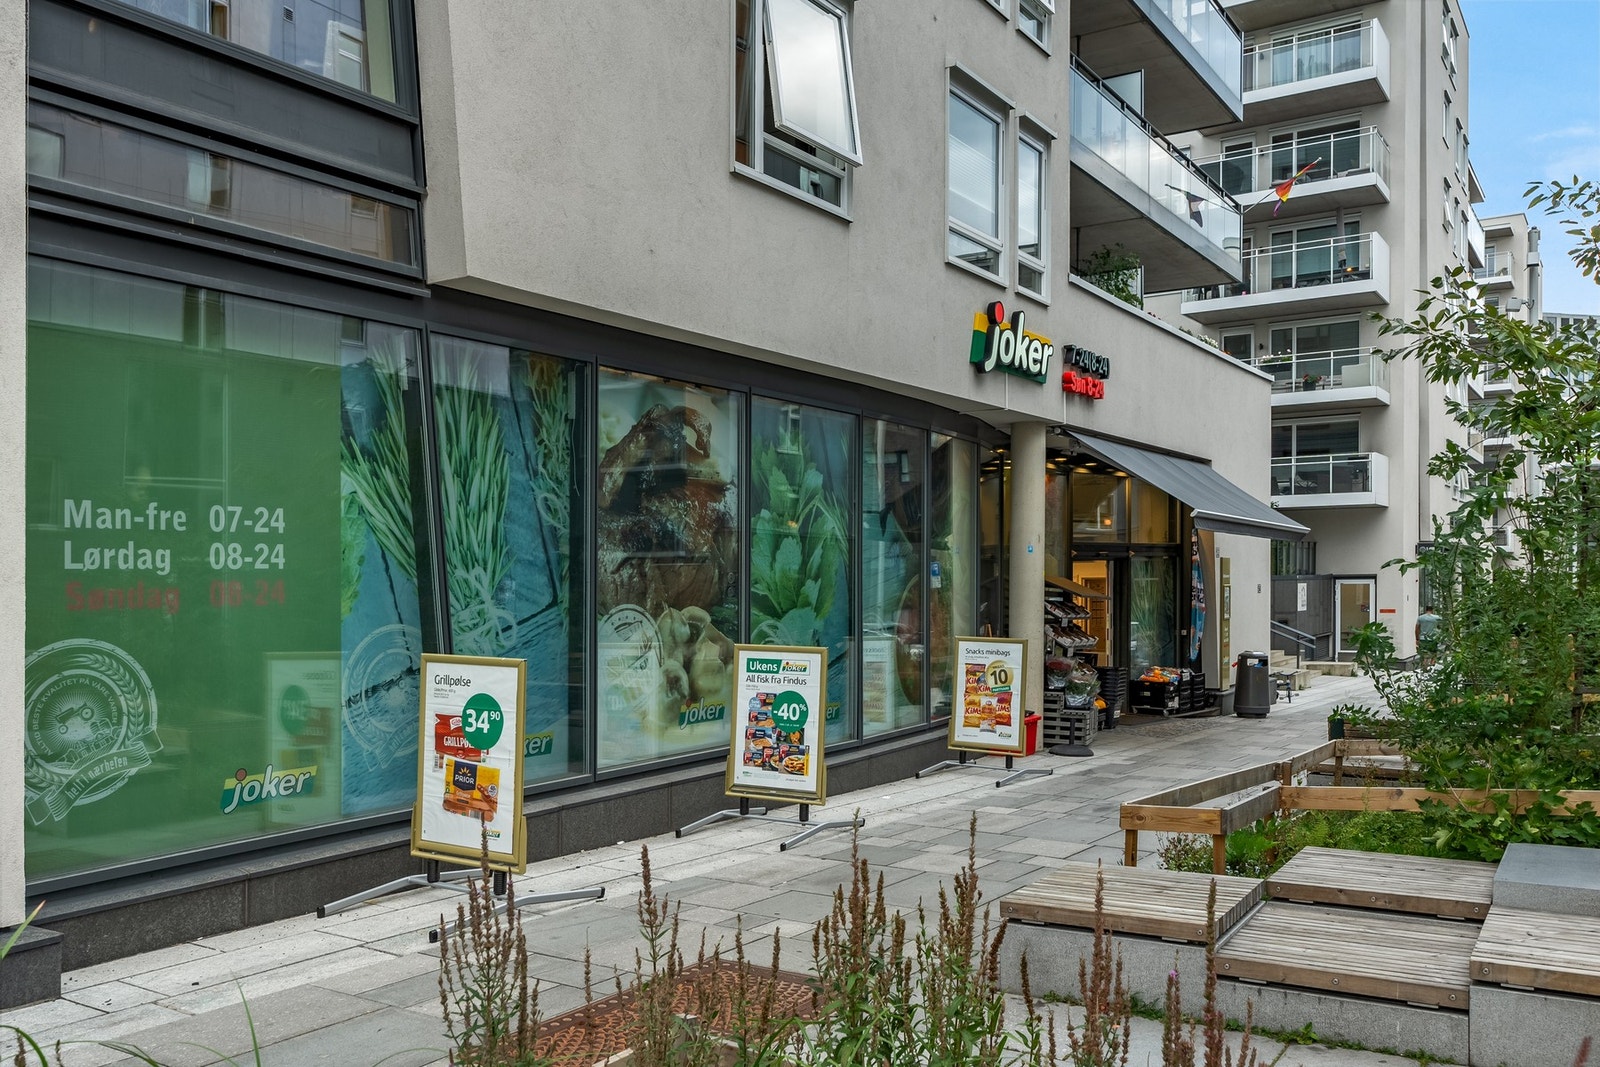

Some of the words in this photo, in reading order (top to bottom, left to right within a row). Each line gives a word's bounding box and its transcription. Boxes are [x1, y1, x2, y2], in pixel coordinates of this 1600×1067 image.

[983, 300, 1054, 376] joker
[64, 499, 187, 532] Man-fre
[209, 504, 286, 534] 07-24
[64, 540, 171, 576] Lørdag
[209, 542, 286, 570] 08-24
[66, 580, 181, 614] Søndag
[209, 578, 286, 608] 08-24
[749, 660, 778, 672] Ukens
[965, 647, 985, 655] Snacks
[985, 648, 1011, 657] minibags
[434, 674, 472, 688] Grillpølse
[745, 674, 756, 683] All
[757, 674, 770, 684] fisk
[770, 674, 782, 685] fra
[783, 675, 807, 686] Findus
[990, 668, 1009, 686] 10
[32, 702, 45, 730] BESTE
[41, 678, 78, 702] KVALITET
[679, 697, 724, 731] joker
[221, 763, 312, 815] joker
[454, 774, 476, 785] PRIOR
